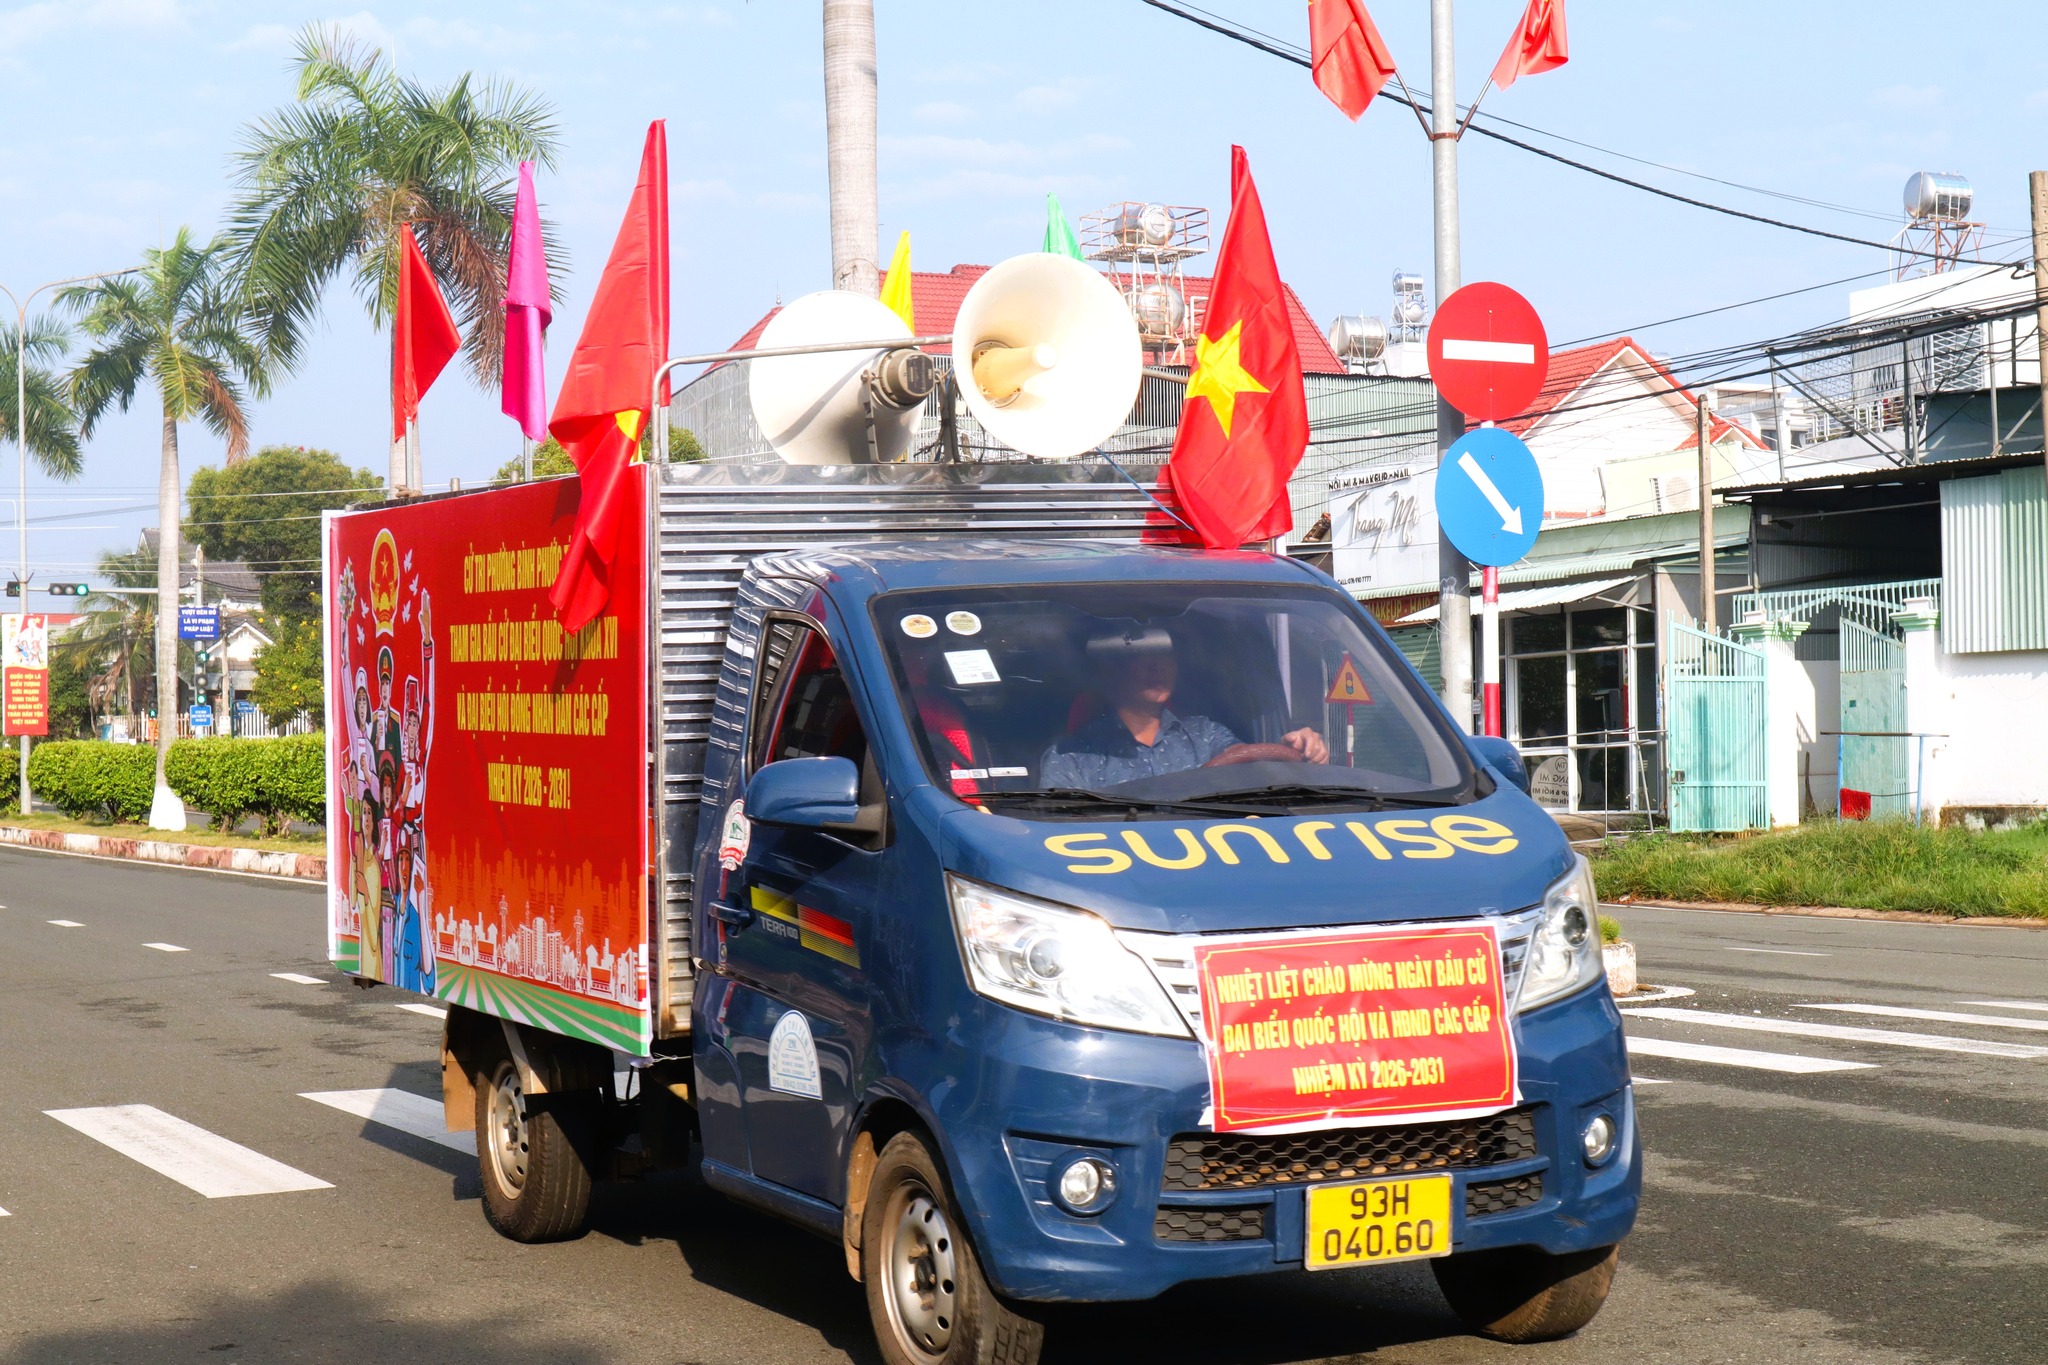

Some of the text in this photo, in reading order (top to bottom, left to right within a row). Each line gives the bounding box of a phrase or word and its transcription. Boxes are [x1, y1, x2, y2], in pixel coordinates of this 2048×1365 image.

[1352, 477, 1358, 486] &
[450, 624, 469, 662] THAM
[470, 623, 482, 662] GIA
[603, 616, 618, 659] XVI
[457, 684, 467, 731] VÀ
[532, 684, 554, 735] NHÂN
[555, 684, 572, 735] DÂN
[574, 684, 590, 736] CÁC
[591, 677, 608, 737] CẤP
[488, 754, 511, 812] NHIỆM
[512, 755, 523, 804] KỲ
[524, 765, 542, 807] 2026
[759, 915, 787, 938] TERA
[1216, 948, 1488, 1007] NHIỆT LIỆT CHÀO MỪNG NGÀY BẦU CỬ
[1222, 1023, 1251, 1058] ĐẠI
[1252, 1008, 1290, 1050] BIỂU
[1292, 1006, 1336, 1050] QUỐC
[1337, 1007, 1367, 1048] HỘI
[1368, 1005, 1391, 1040] VÀ
[1433, 1001, 1463, 1036] CÁC
[1463, 995, 1491, 1033] CẤP
[1292, 1056, 1446, 1098] NHIỆM KỲ 2026-2031
[1350, 1183, 1410, 1220] 93H
[1324, 1219, 1433, 1261] 040.60
